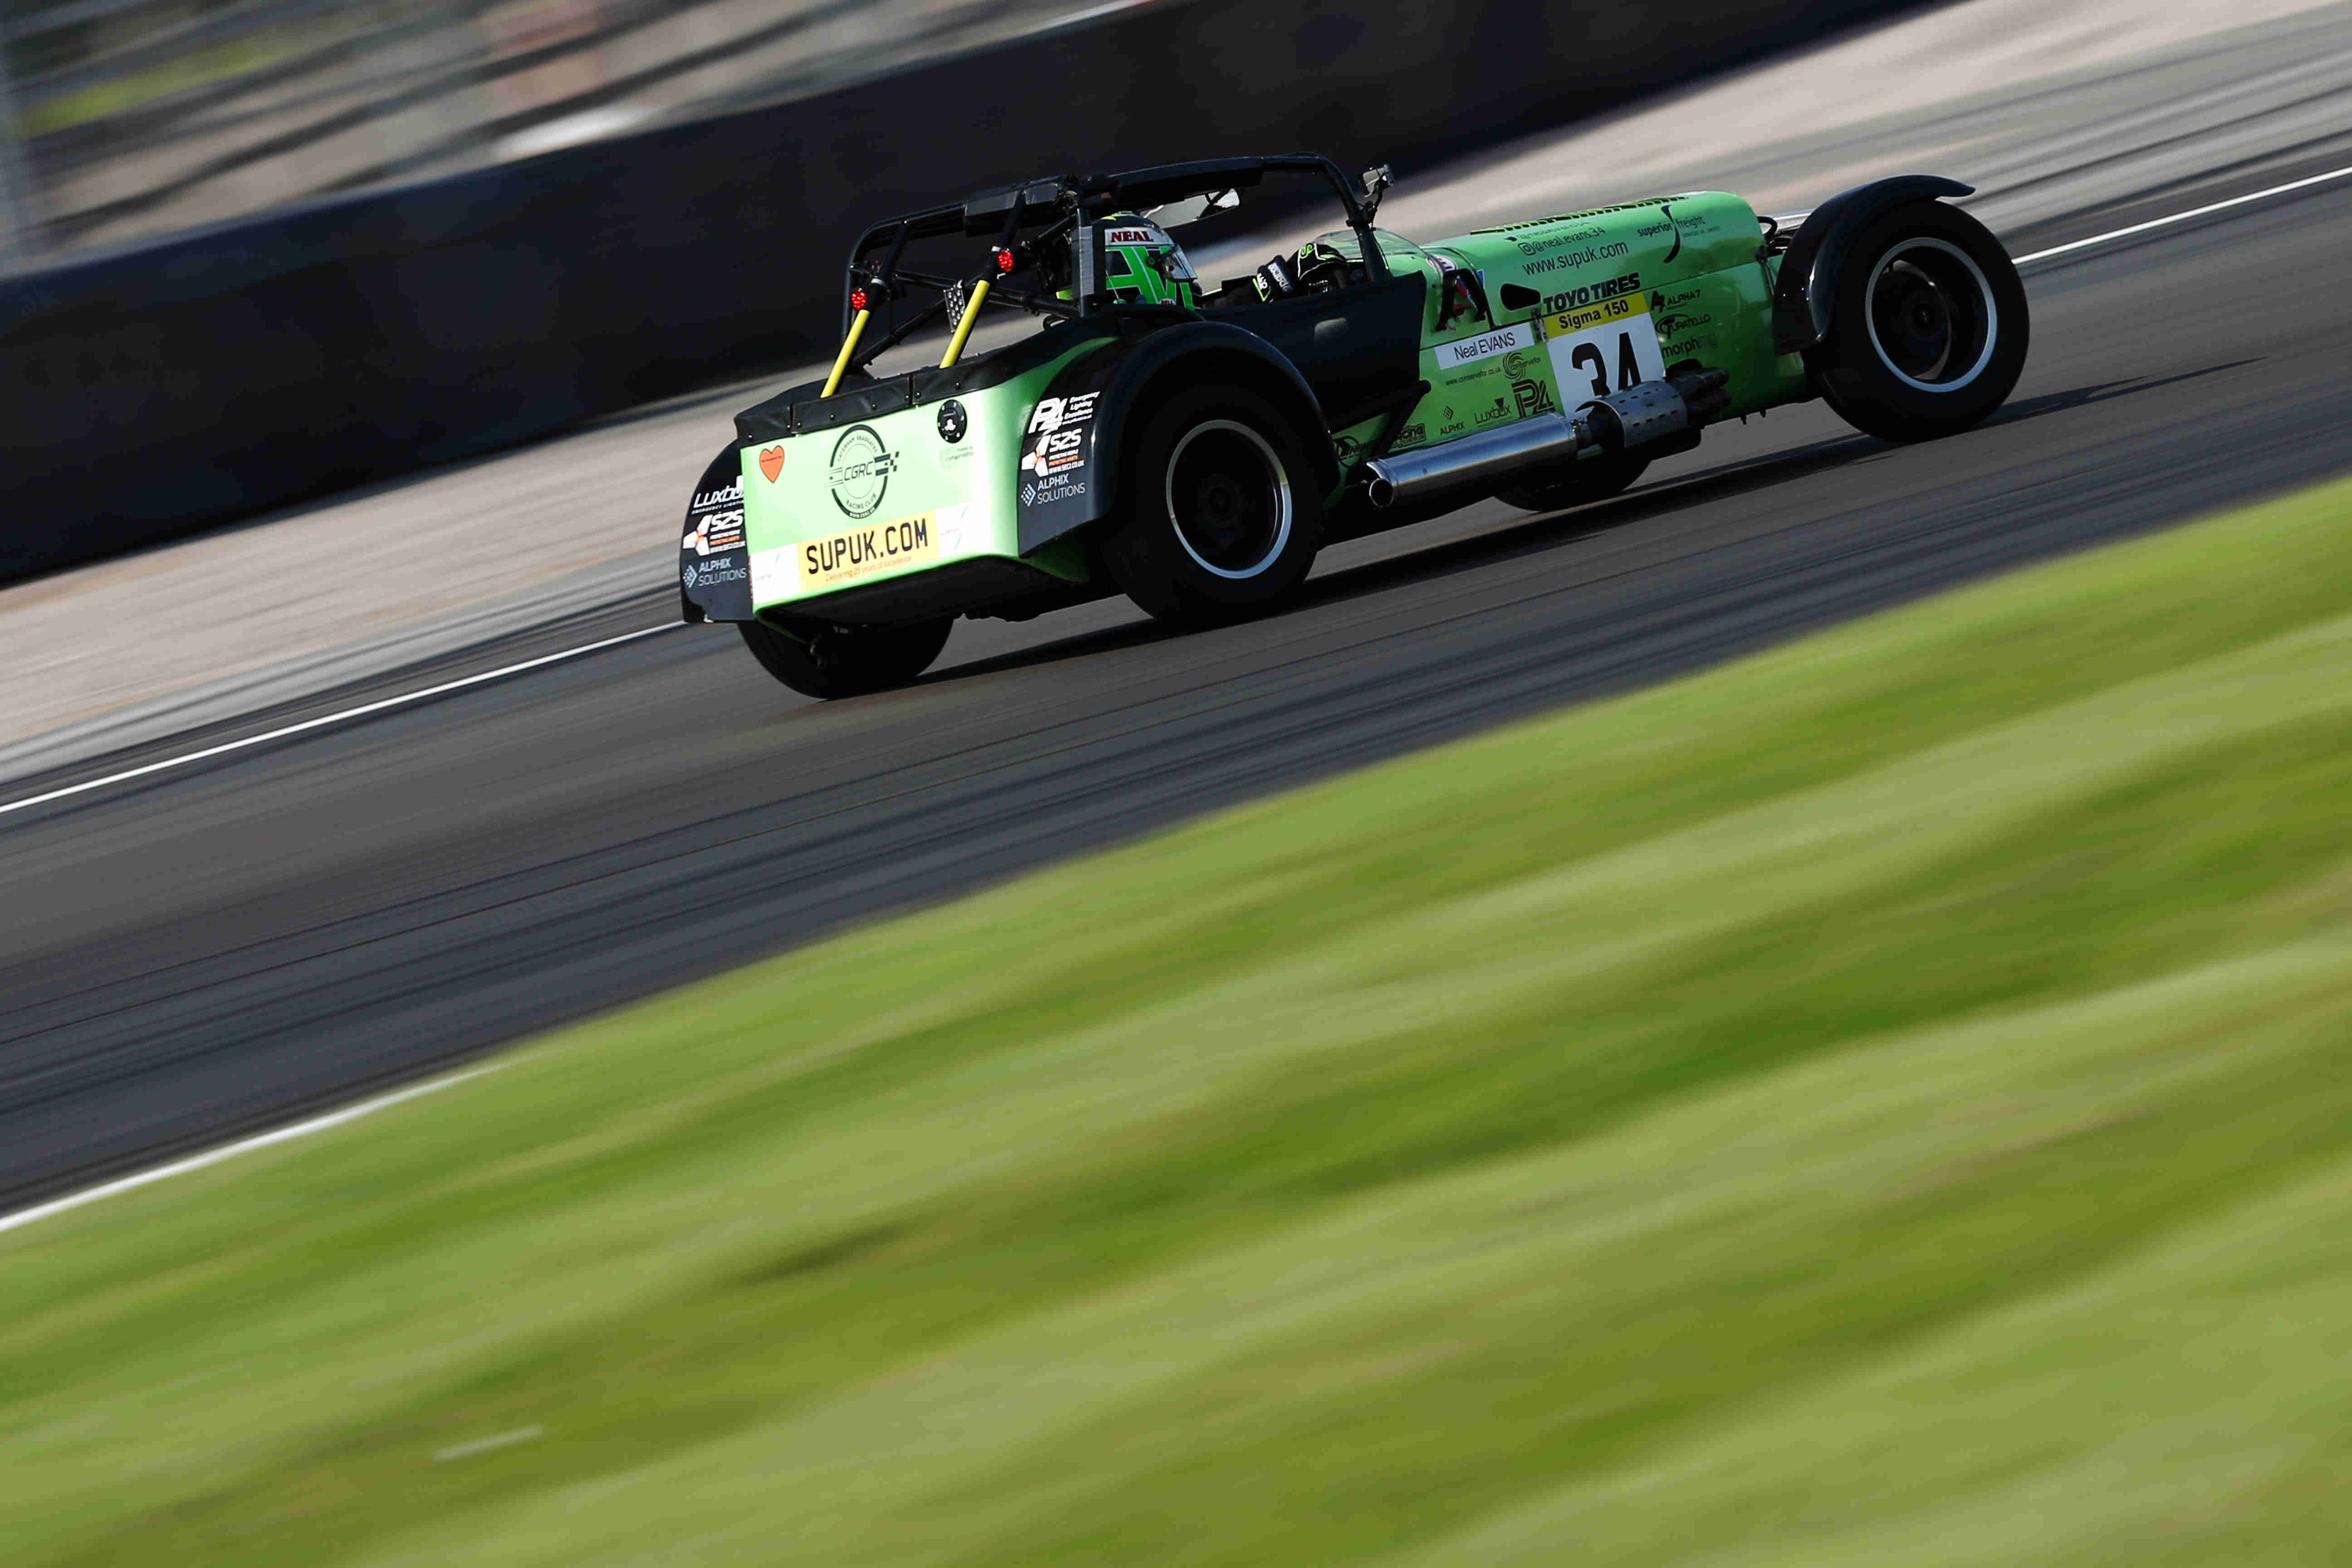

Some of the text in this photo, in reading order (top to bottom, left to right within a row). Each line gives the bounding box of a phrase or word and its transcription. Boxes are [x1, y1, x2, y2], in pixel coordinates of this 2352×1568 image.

[1111, 231, 1154, 243] NEAL
[1637, 222, 1673, 237] superior
[1676, 216, 1706, 229] freight
[1532, 226, 1606, 251] @neal.evans.34
[1522, 241, 1629, 276] www.supuk.com
[1543, 272, 1641, 313] TOYO TIRES
[1667, 289, 1701, 305] ALPHA7
[1559, 309, 1602, 330] Sigma
[1603, 299, 1629, 317] 150
[1454, 333, 1516, 361] Neal EVANS
[1440, 421, 1465, 436] ALPHIX
[844, 461, 873, 481] CGRC
[1038, 473, 1069, 491] ALPHIX
[1038, 482, 1086, 505] SOLUTIONS
[806, 517, 928, 575] SUPUK.COM
[699, 557, 732, 573] ALPHIX
[698, 568, 747, 587] SOLUTIONS
